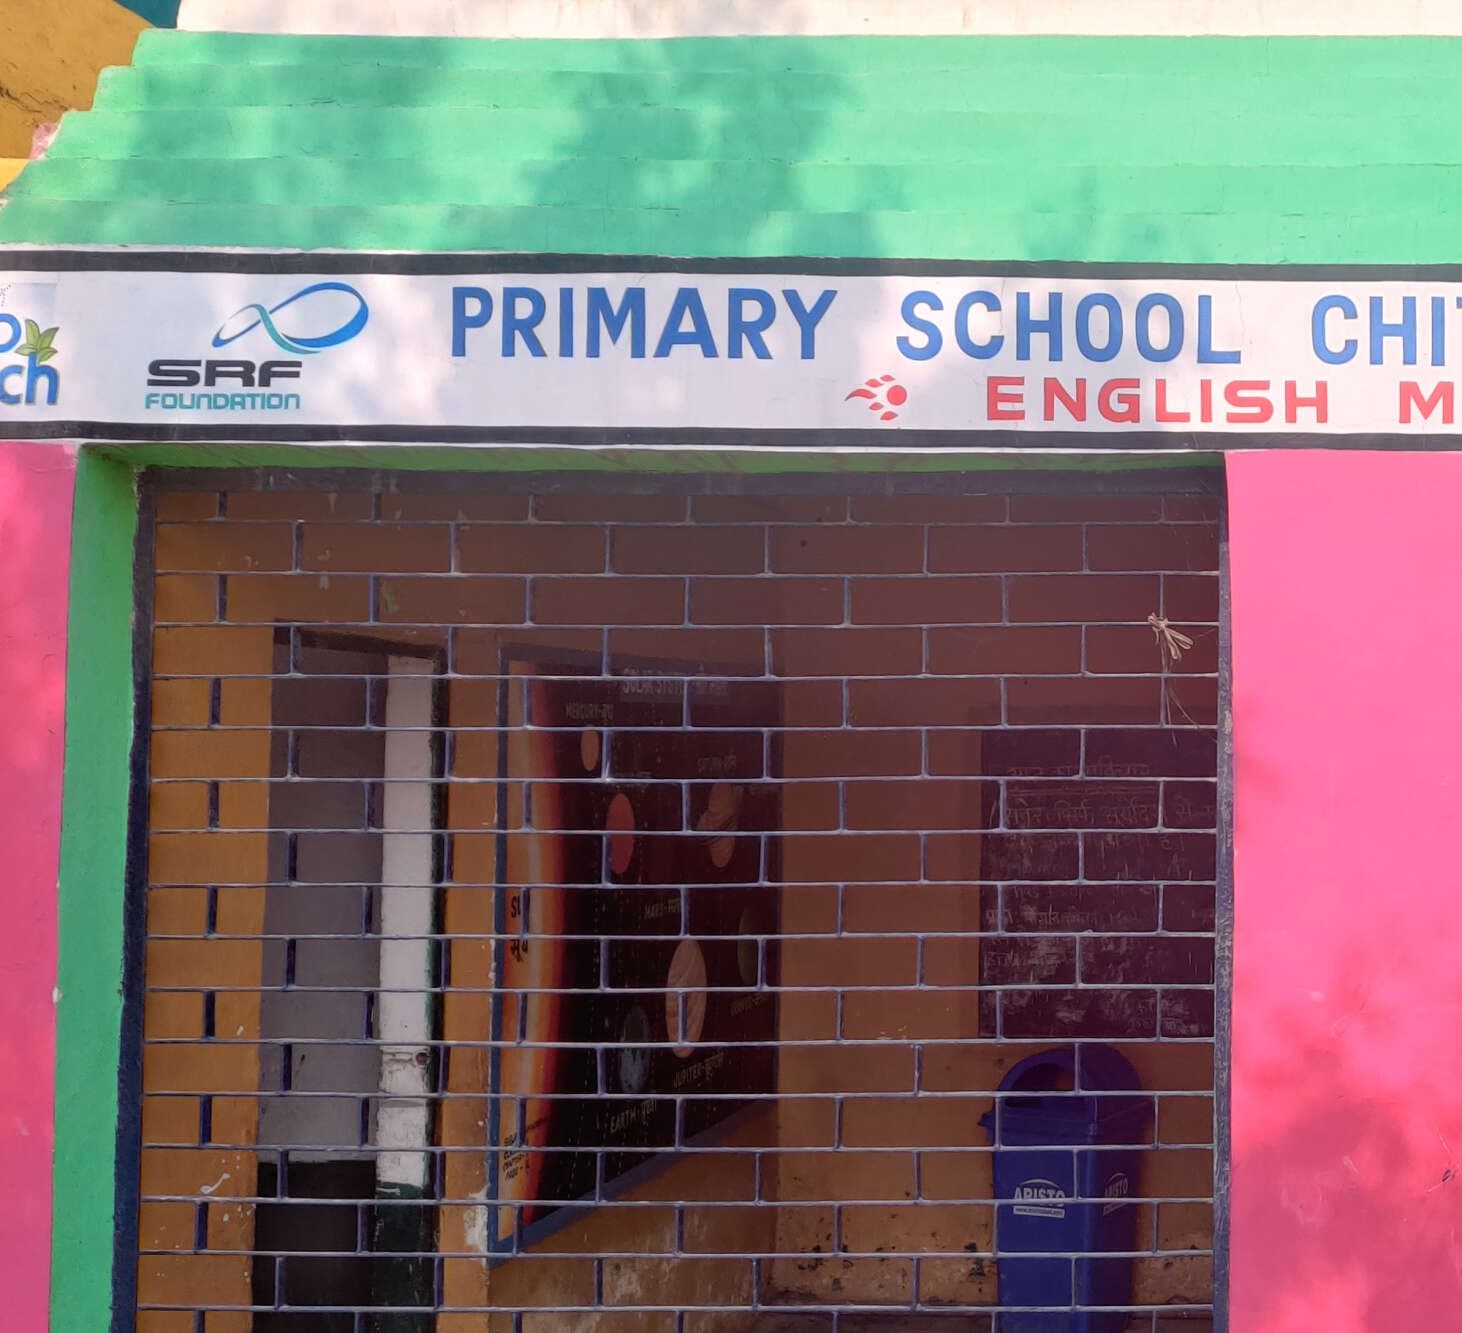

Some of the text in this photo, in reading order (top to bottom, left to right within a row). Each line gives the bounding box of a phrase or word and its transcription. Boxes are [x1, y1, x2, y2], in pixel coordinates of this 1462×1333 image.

[451, 286, 838, 360] PRIMARY
[896, 290, 1241, 364] SCHOOL
[147, 359, 302, 387] SRF
[145, 392, 301, 410] FOUNDATION
[986, 376, 1328, 424] ENGLISH
